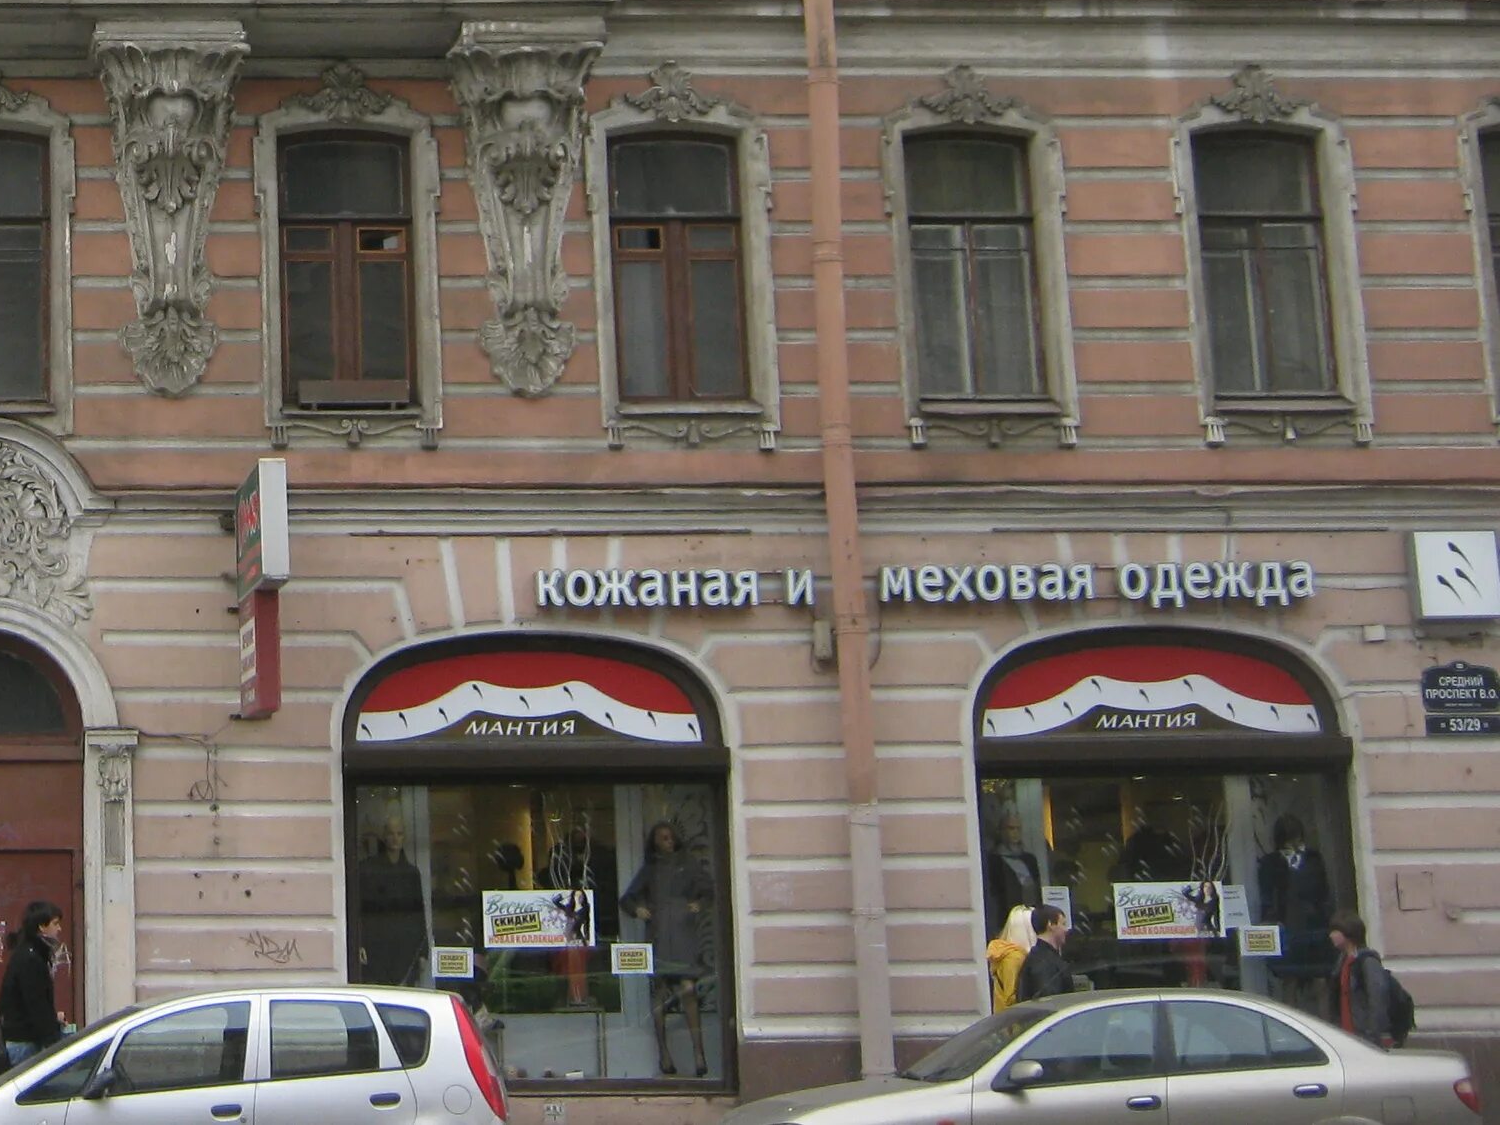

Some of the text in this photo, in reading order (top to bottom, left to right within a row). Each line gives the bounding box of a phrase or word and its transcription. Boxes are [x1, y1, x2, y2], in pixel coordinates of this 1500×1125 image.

[536, 560, 1316, 608] кожаная и меховая одежда
[1438, 675, 1484, 687] СРЕДНИЙ
[1425, 688, 1499, 699] ПРОСПЕКТ В.О.
[464, 719, 576, 736] МАНТИЯ
[1095, 712, 1197, 729] МАНТИЯ
[1449, 718, 1481, 732] 53/29
[485, 894, 537, 915] Весна
[1127, 905, 1168, 919] СКИДКИ
[494, 914, 537, 927] СКИДКИ
